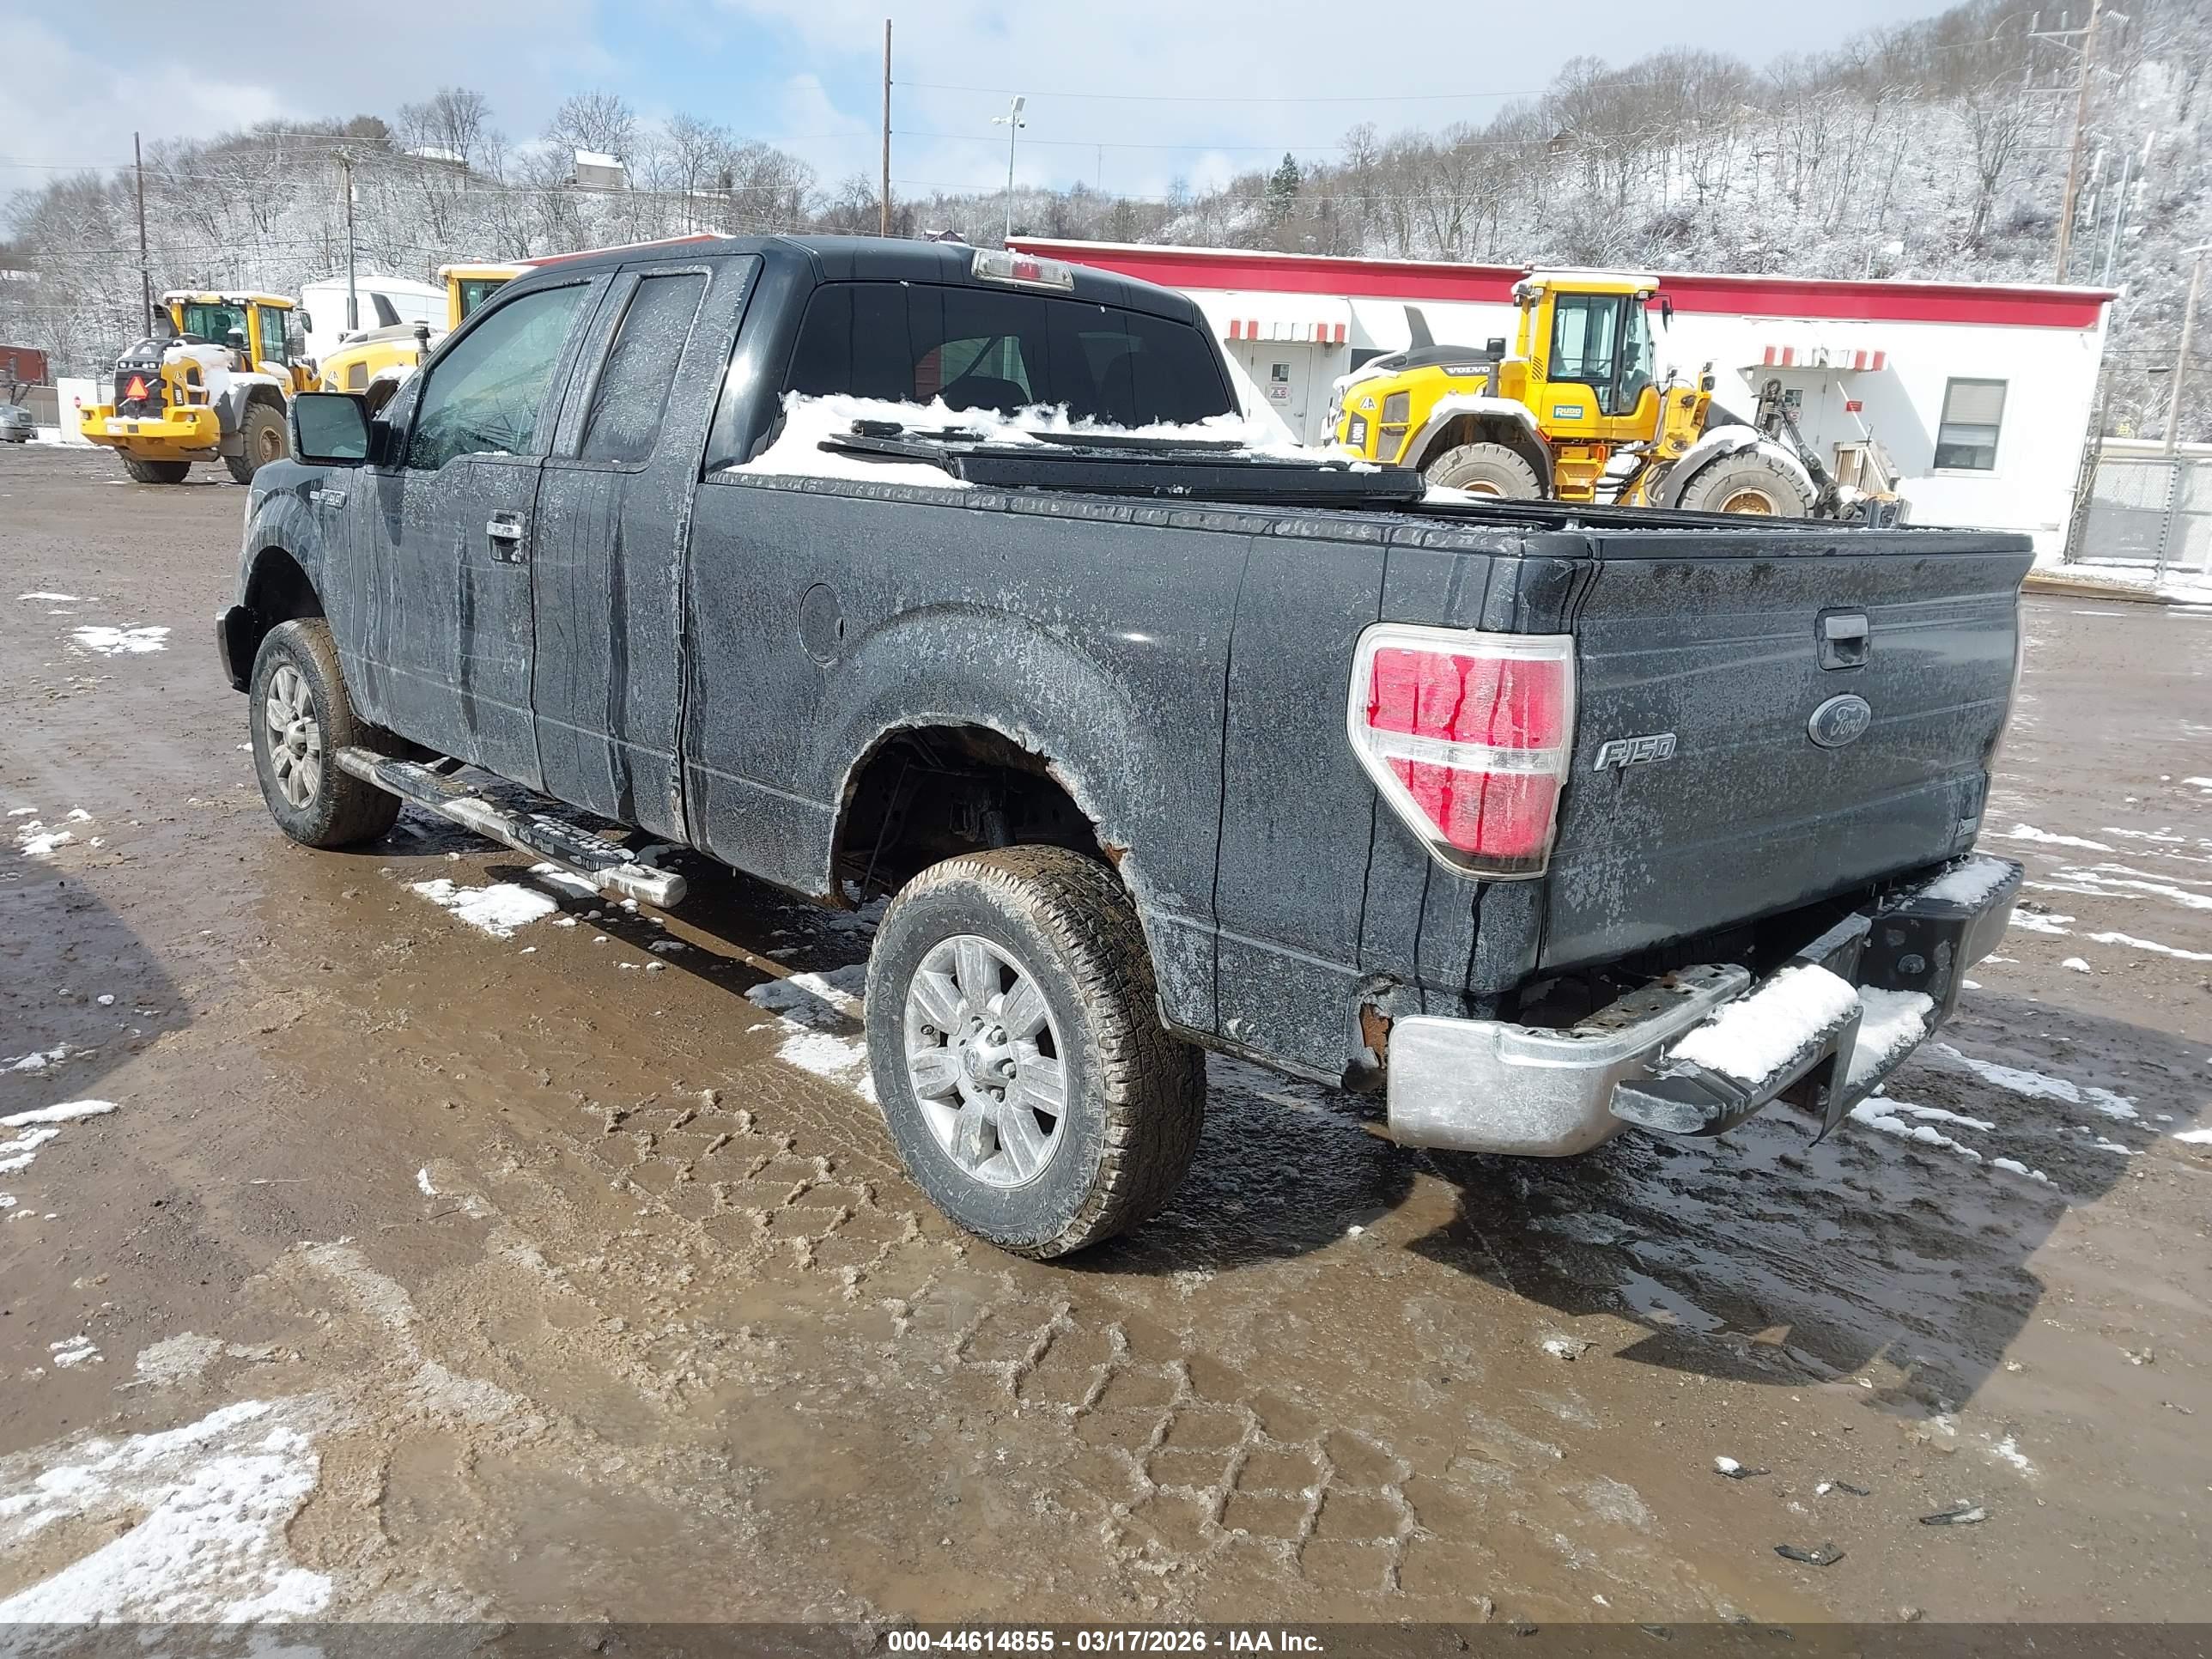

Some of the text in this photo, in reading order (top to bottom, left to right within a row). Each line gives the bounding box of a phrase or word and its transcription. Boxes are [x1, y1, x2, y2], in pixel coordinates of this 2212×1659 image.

[1556, 407, 1581, 416] RUDD
[1352, 422, 1364, 443] L90H
[1830, 705, 1864, 737] Ford
